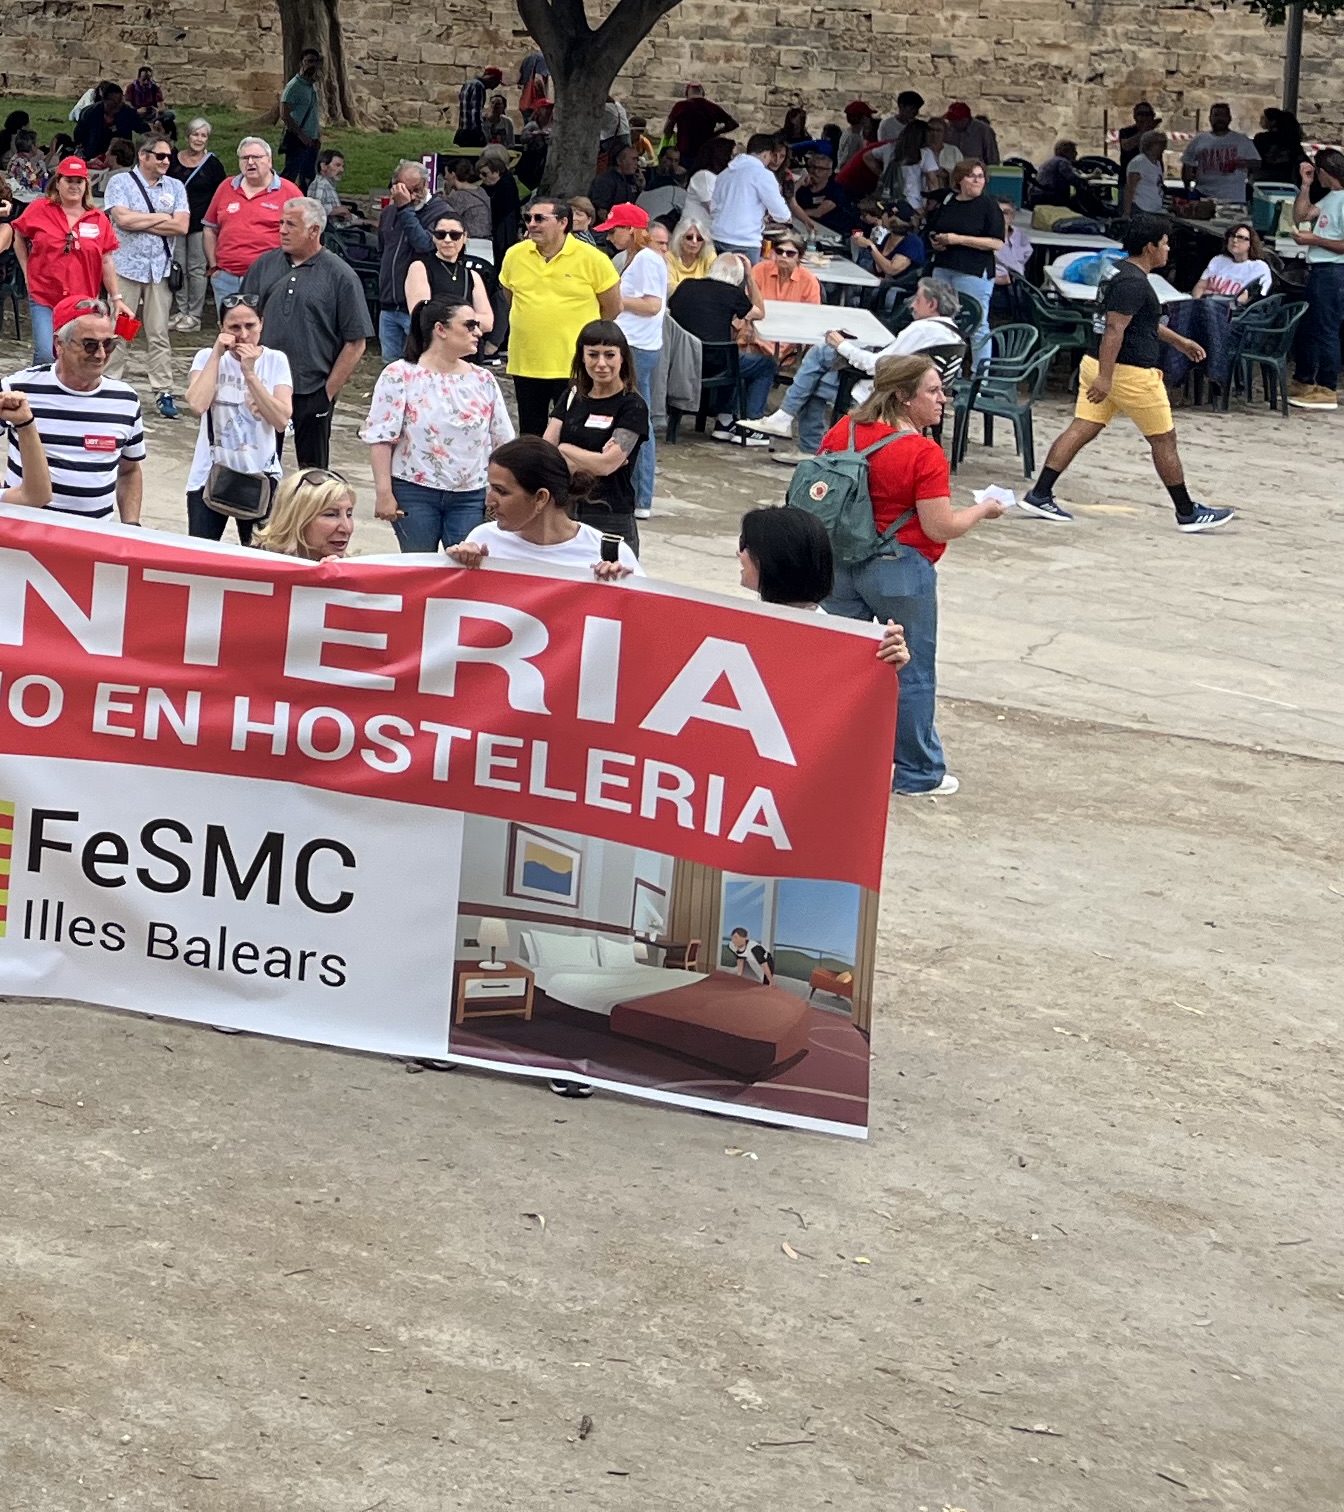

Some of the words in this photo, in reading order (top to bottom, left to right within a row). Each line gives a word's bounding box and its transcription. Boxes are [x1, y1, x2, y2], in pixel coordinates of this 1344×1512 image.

[92, 681, 201, 747] EN
[231, 695, 793, 851] HOSTELERIA
[26, 807, 357, 914] FeSMC
[23, 898, 127, 952] Illes
[146, 921, 348, 988] Balears
